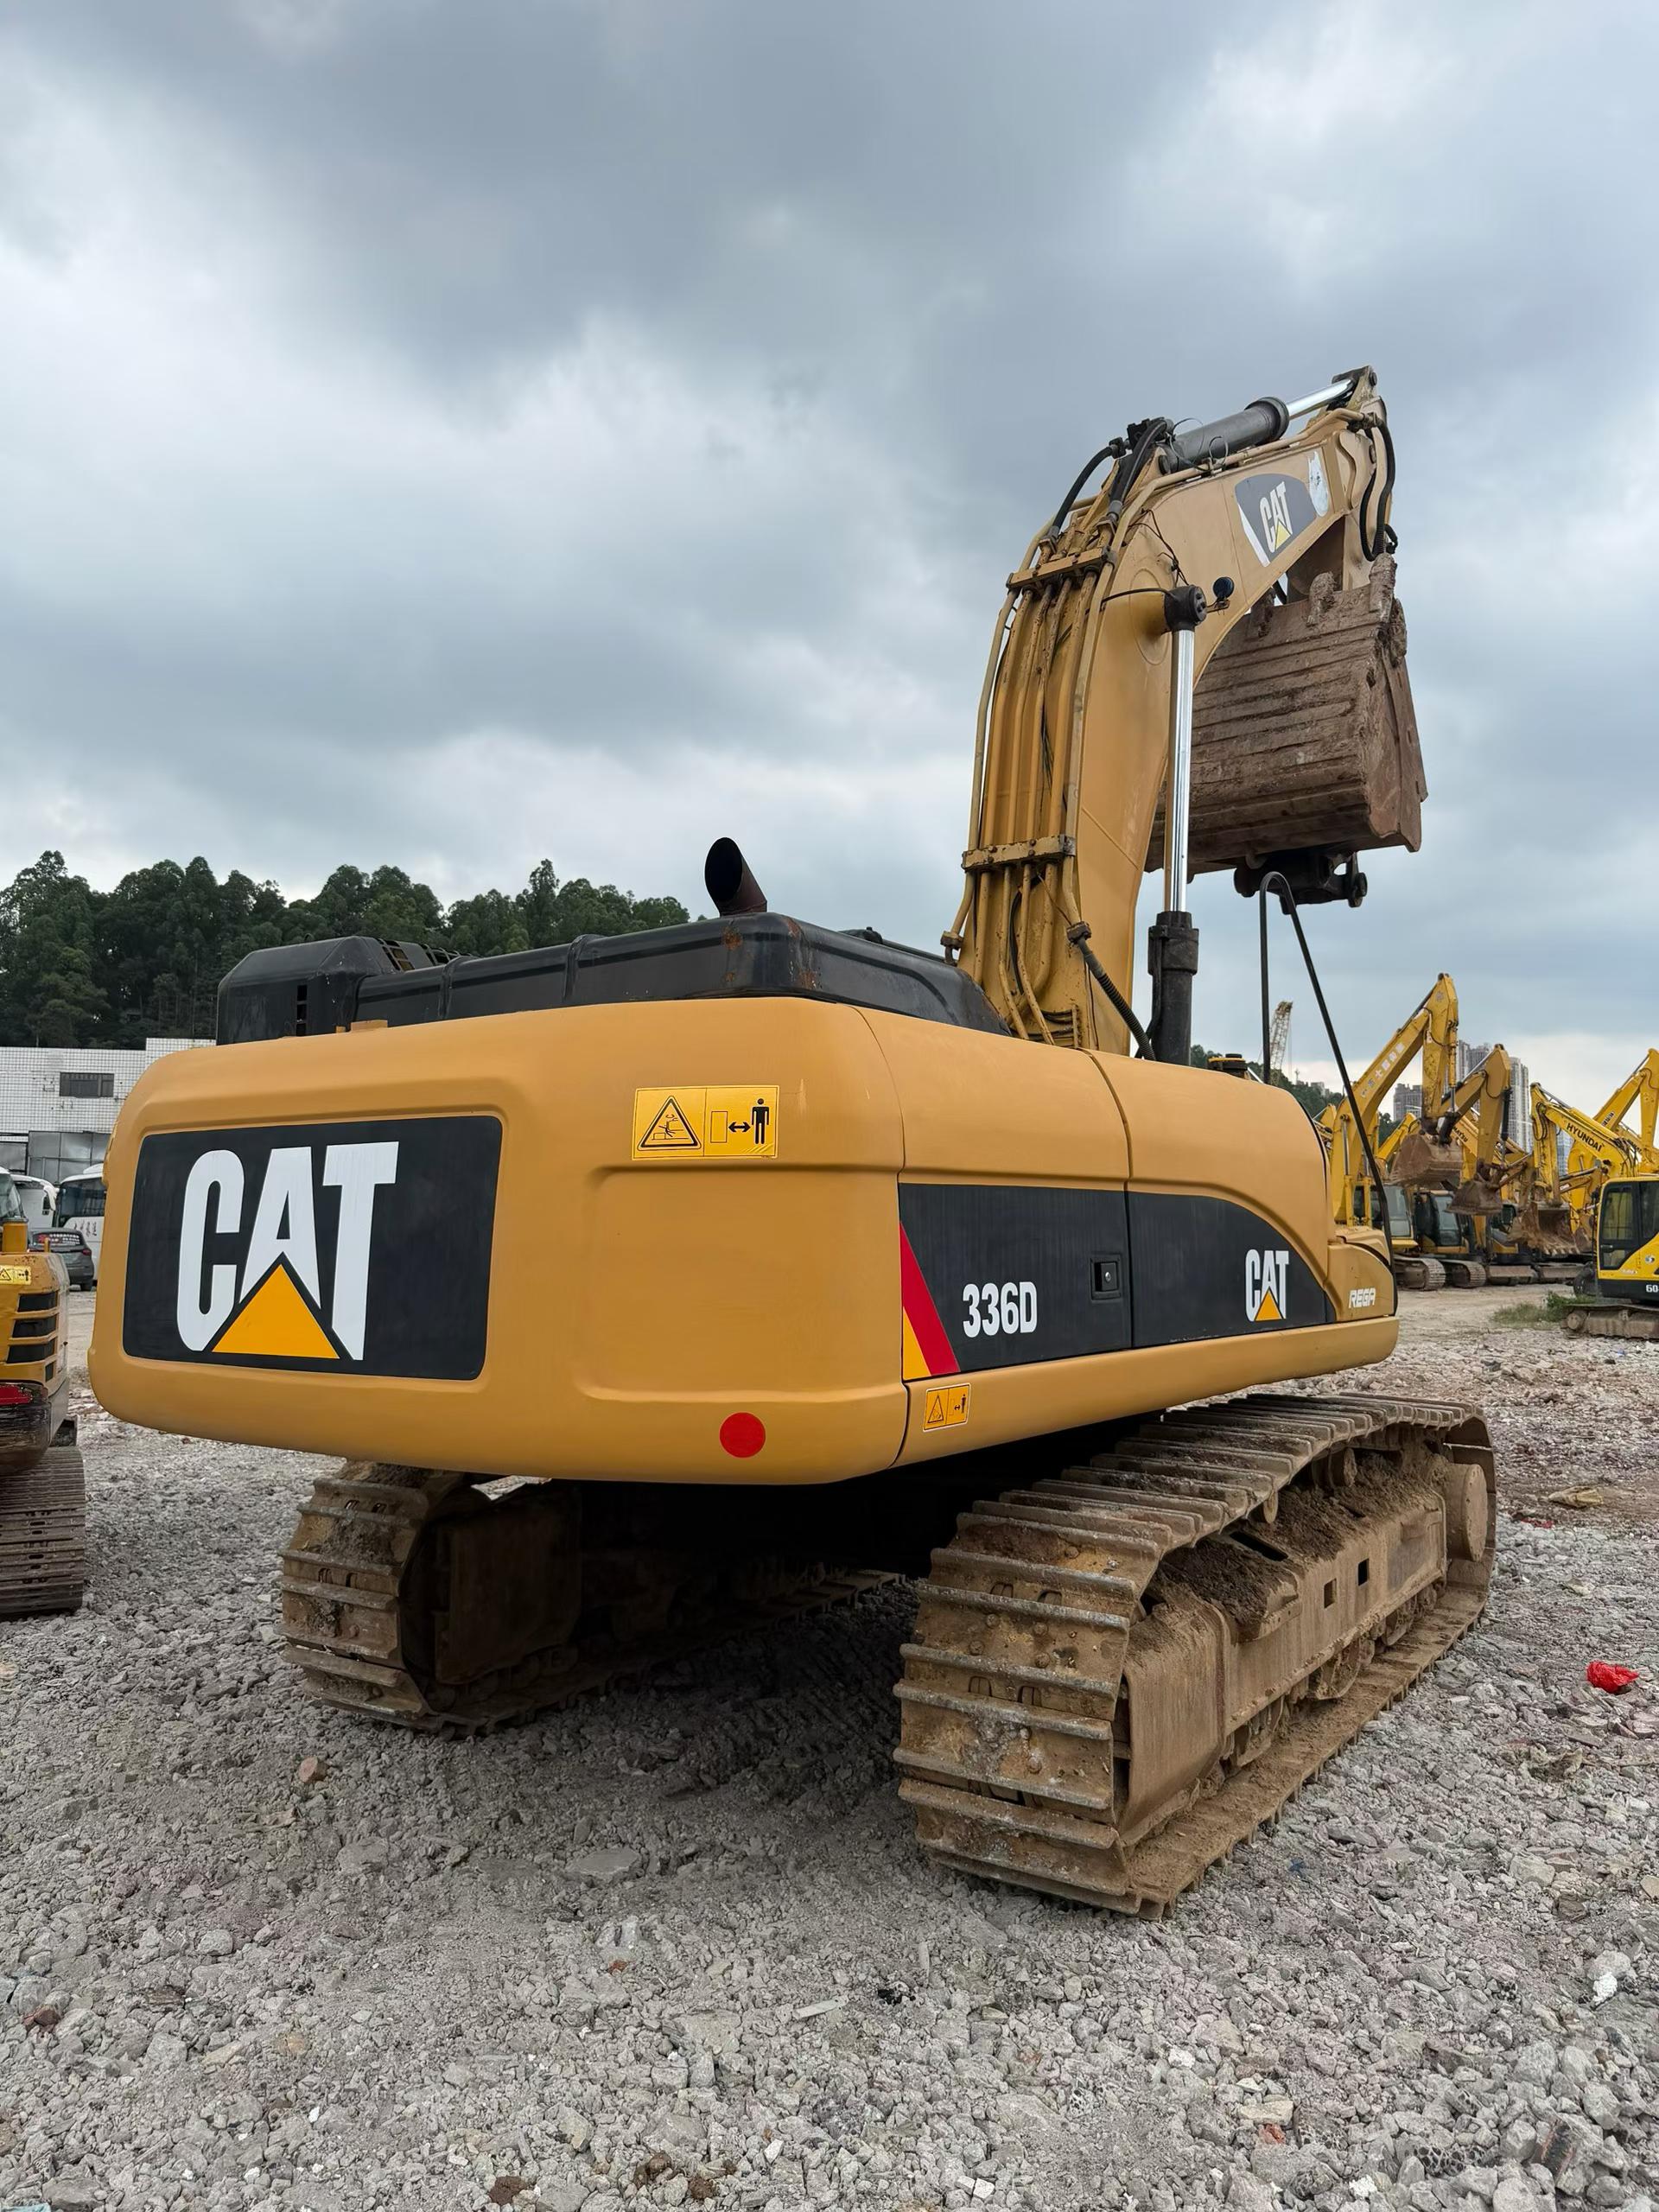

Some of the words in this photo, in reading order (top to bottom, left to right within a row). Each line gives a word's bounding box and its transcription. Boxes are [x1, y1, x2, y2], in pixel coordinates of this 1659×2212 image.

[1260, 481, 1293, 553] CAT
[1452, 1126, 1468, 1142] MATSU
[1567, 1123, 1604, 1152] HYUNDAI
[177, 1141, 398, 1360] CAT
[1245, 1249, 1289, 1321] CAT
[1349, 1287, 1376, 1308] REGA
[1646, 1284, 1659, 1293] 60
[963, 1282, 1037, 1338] 336D
